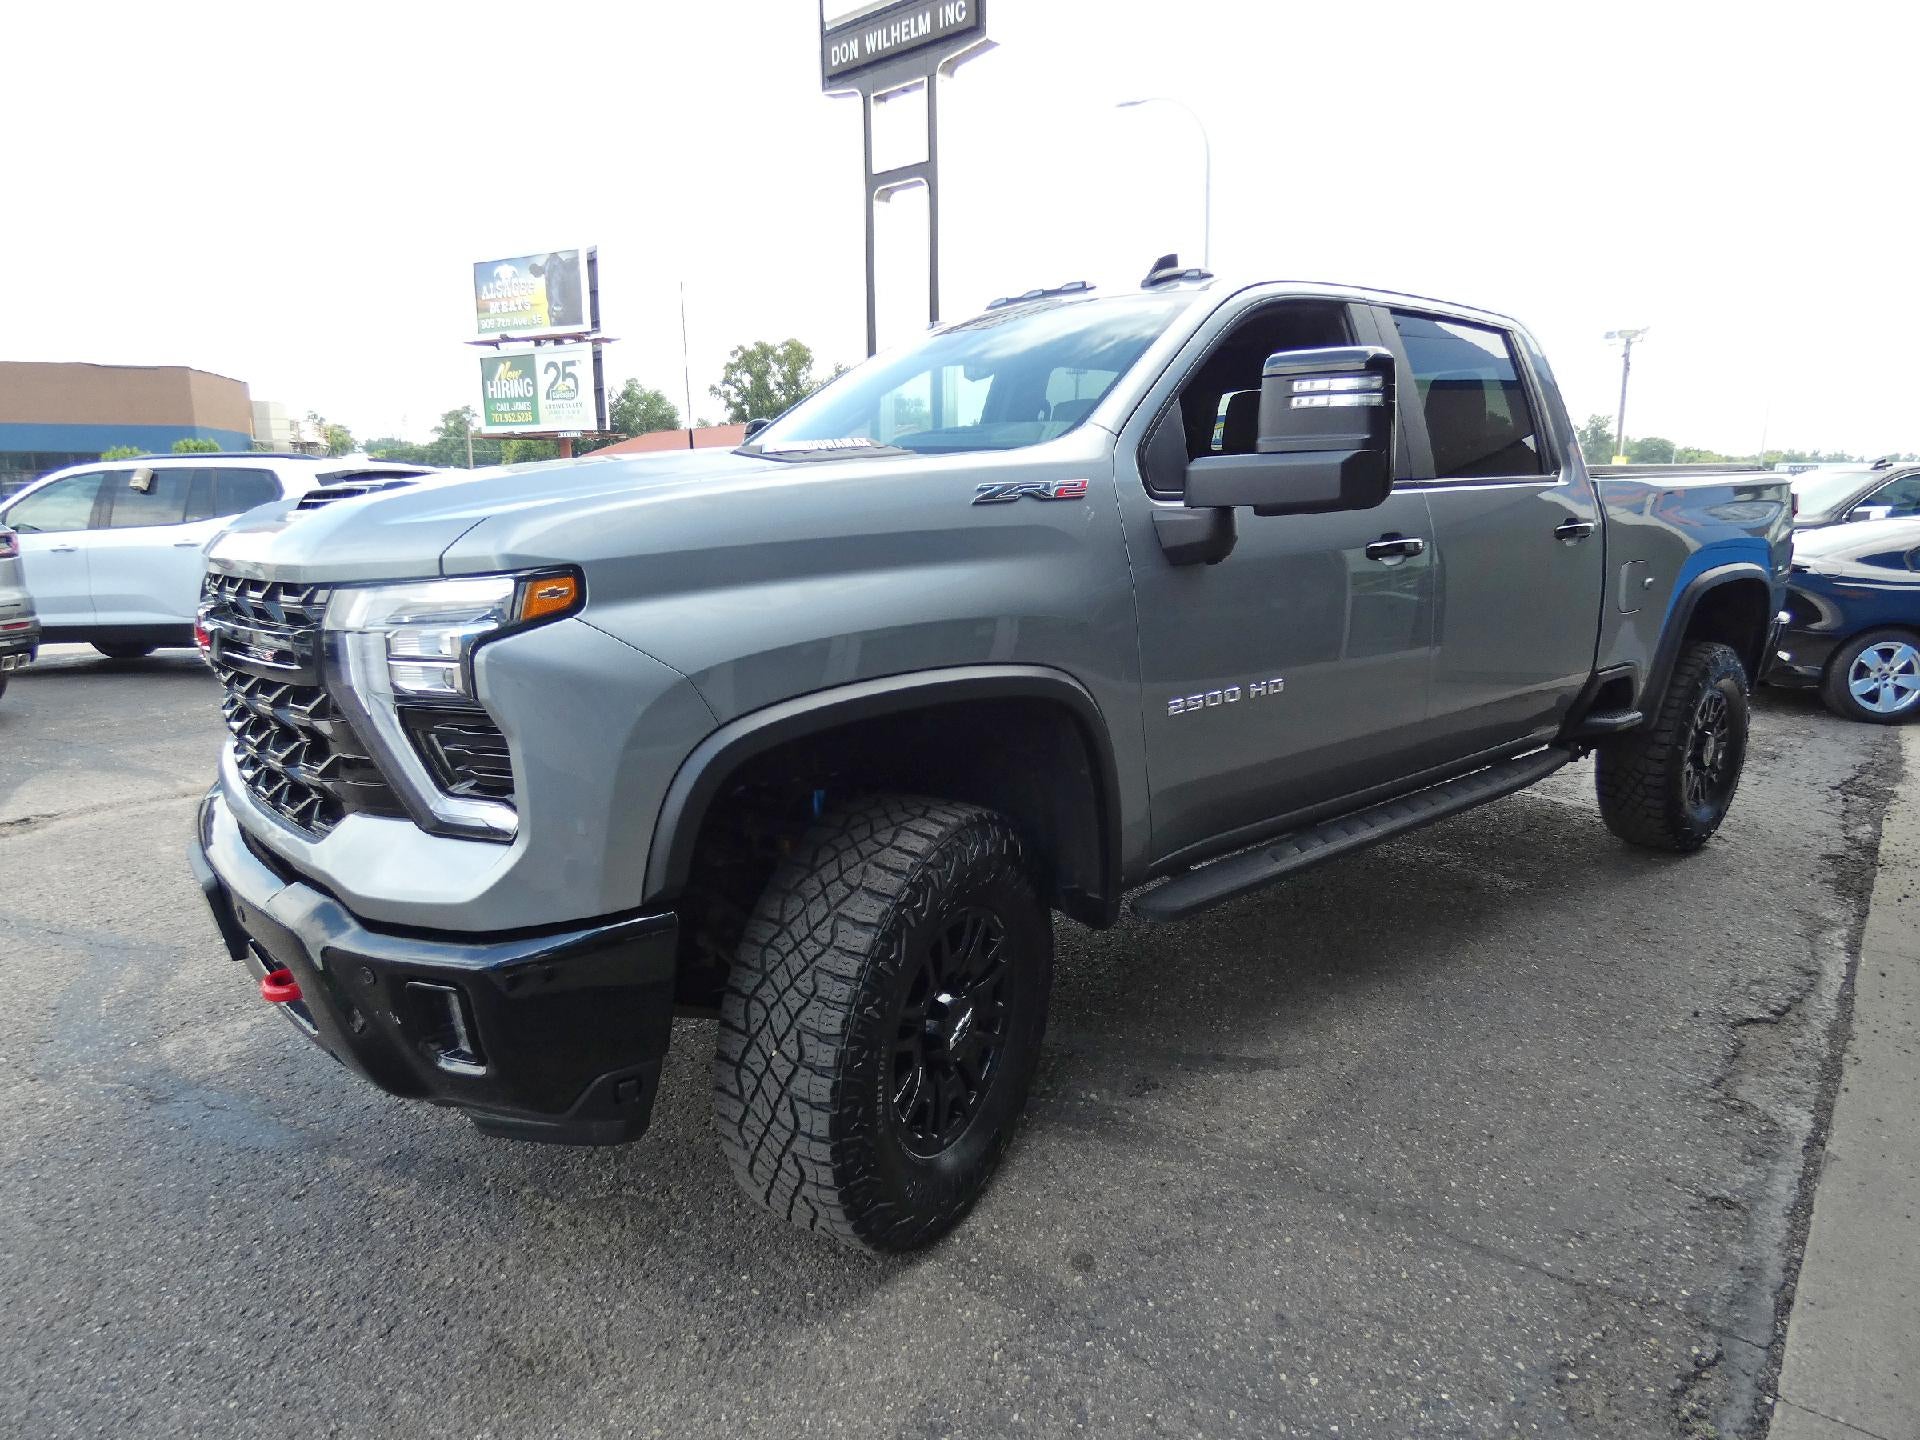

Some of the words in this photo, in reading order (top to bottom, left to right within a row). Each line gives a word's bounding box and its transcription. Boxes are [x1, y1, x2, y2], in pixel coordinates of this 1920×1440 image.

[831, 38, 859, 67] DON
[865, 11, 931, 54] WILHELM
[939, 0, 967, 29] INC
[487, 378, 534, 399] HIRING
[543, 360, 579, 401] 25
[496, 402, 511, 412] CALL
[970, 478, 1089, 504] ZR2
[1167, 686, 1241, 716] 2500
[1249, 678, 1284, 699] HD
